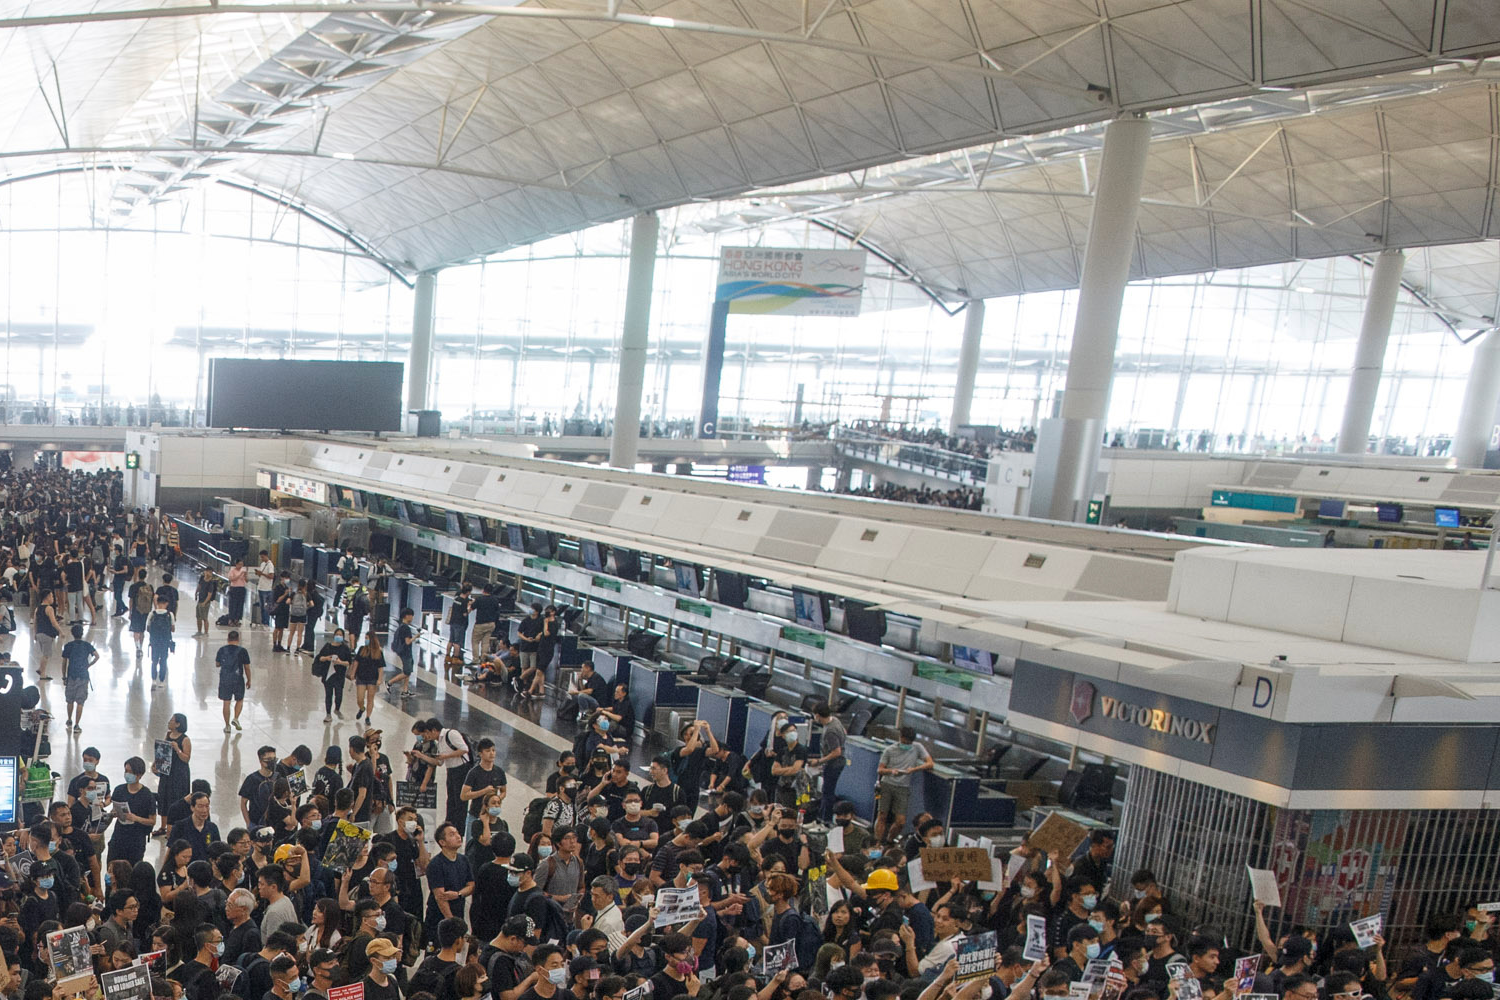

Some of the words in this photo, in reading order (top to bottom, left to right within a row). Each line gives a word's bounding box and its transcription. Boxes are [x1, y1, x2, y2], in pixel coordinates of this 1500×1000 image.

[724, 260, 762, 272] HONG
[764, 261, 803, 272] KONG
[704, 422, 714, 434] C
[1005, 468, 1012, 482] C
[1252, 676, 1273, 708] D
[1101, 696, 1214, 744] VICTORINOX
